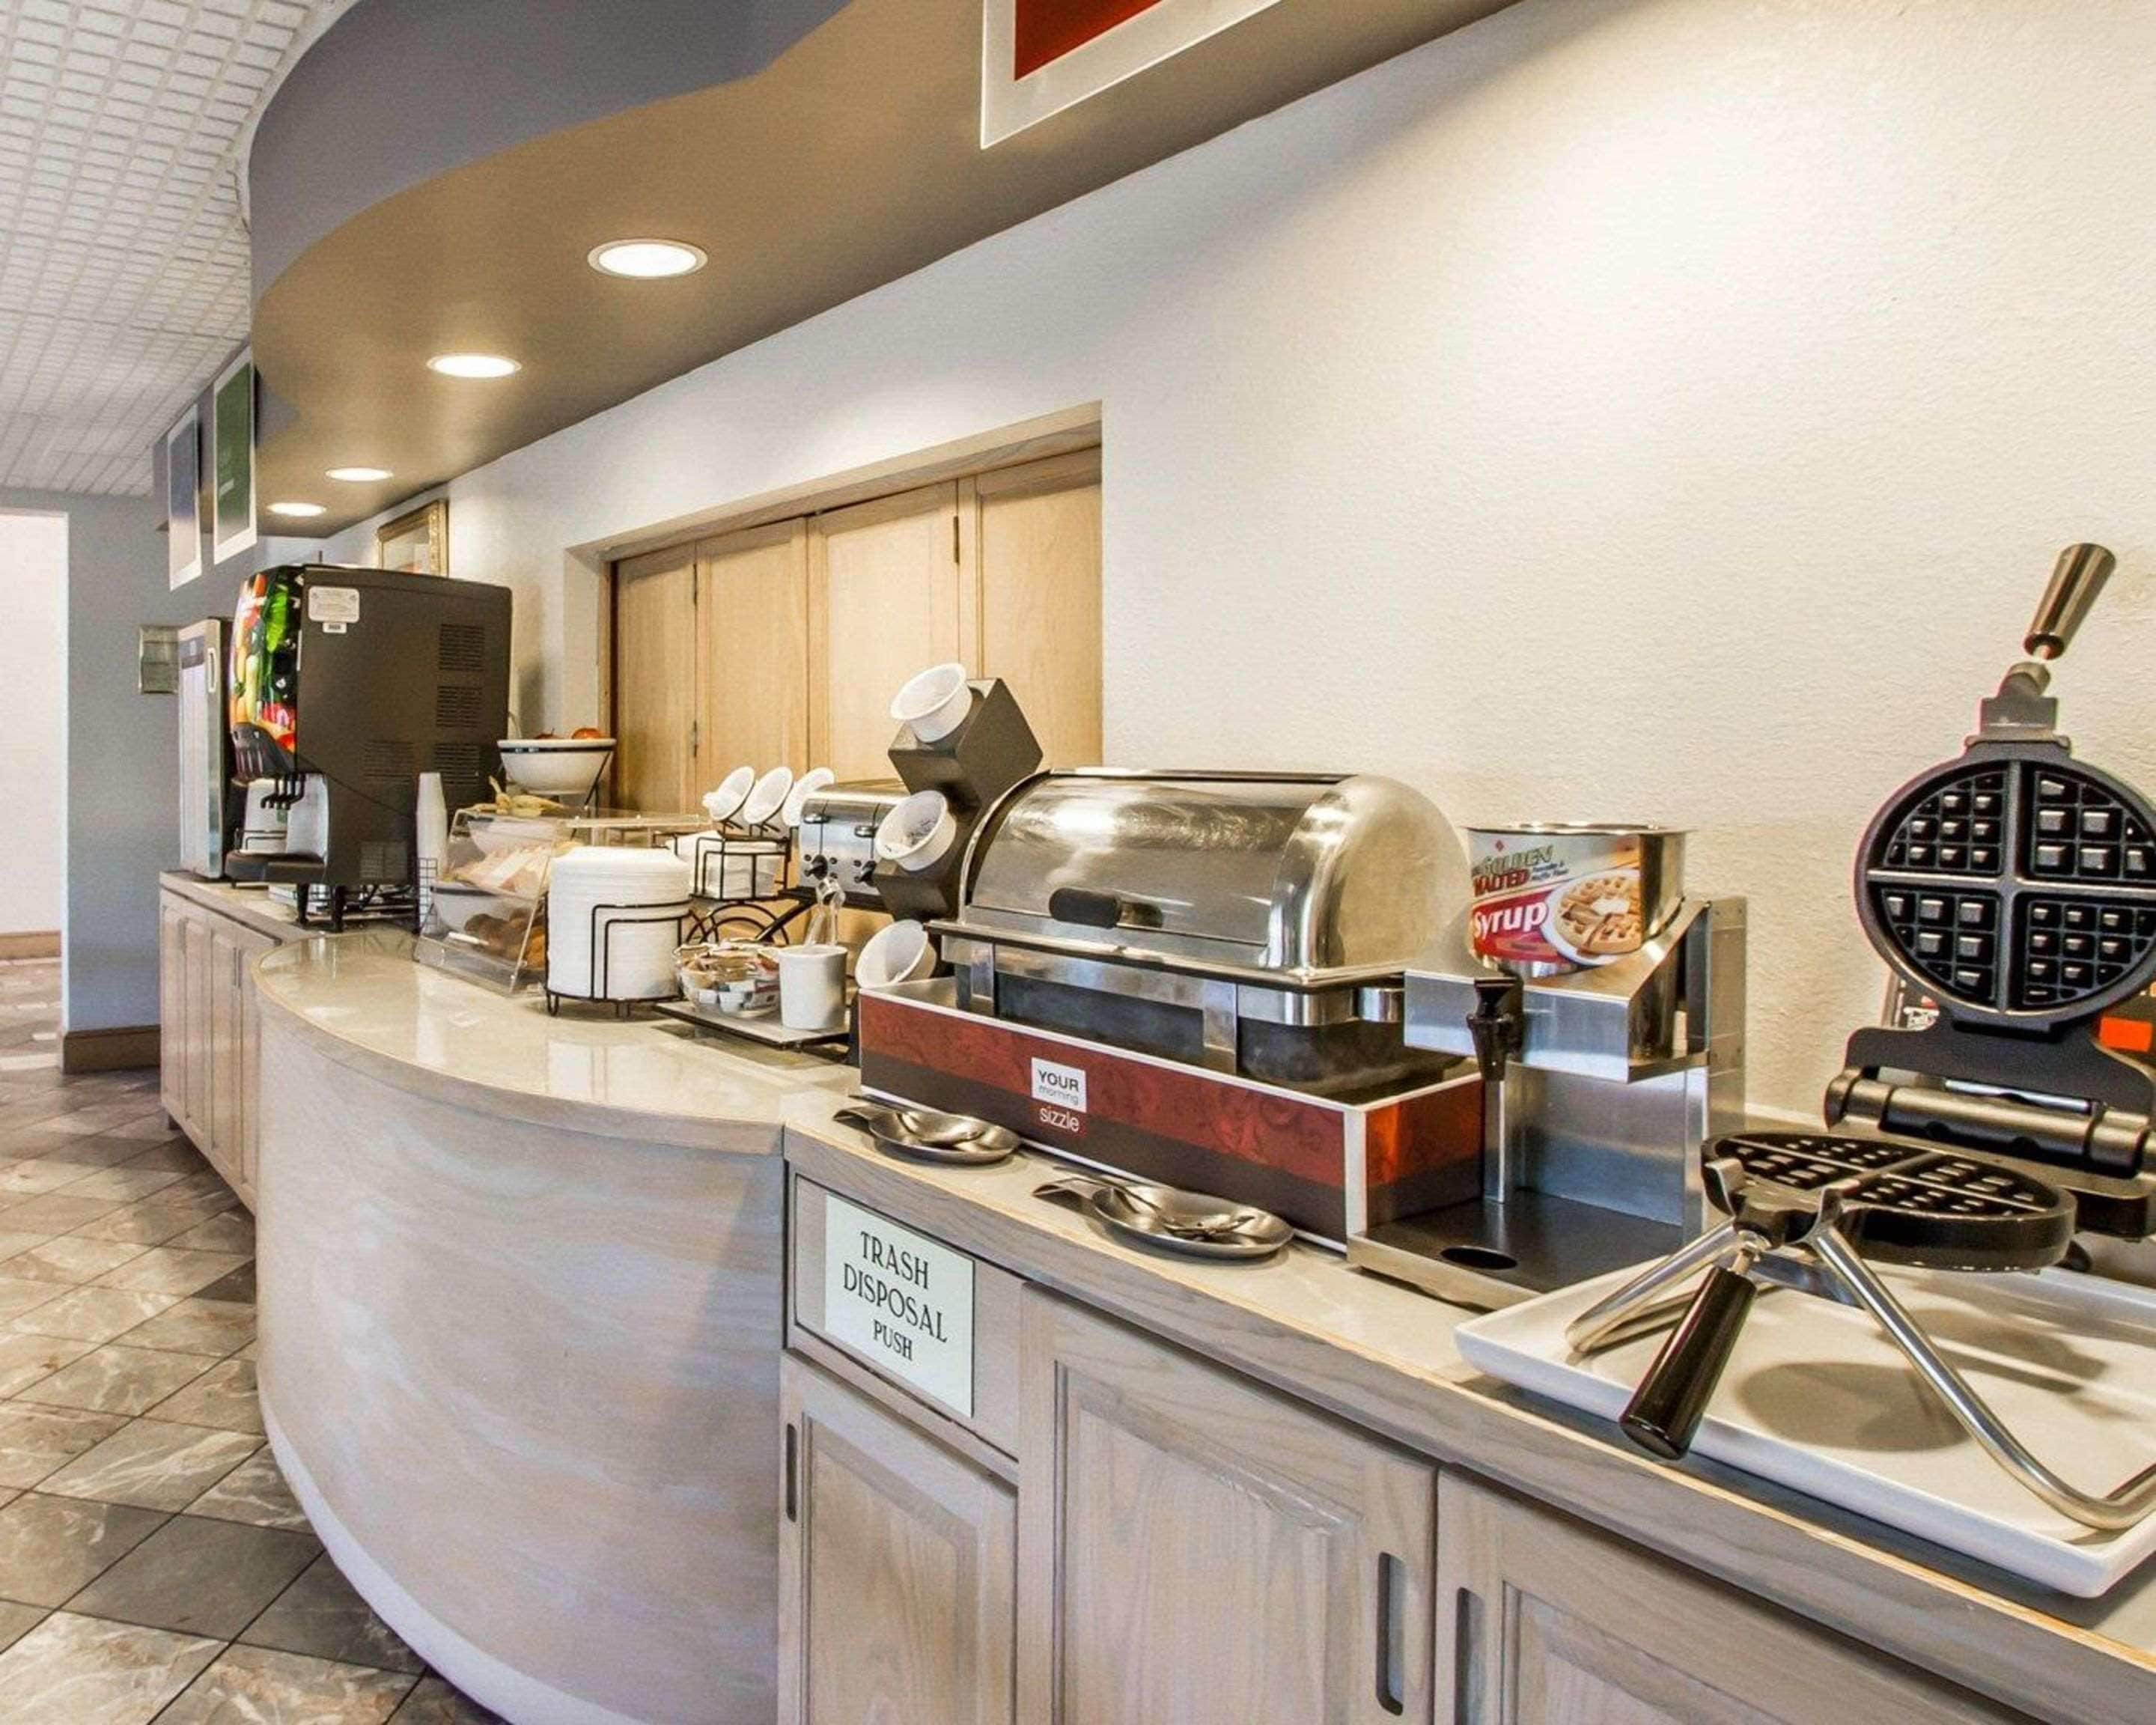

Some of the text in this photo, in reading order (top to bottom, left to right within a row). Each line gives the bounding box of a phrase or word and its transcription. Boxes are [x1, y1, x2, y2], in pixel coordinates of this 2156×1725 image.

[1038, 1069, 1079, 1092] YOUR
[1038, 1085, 1079, 1106] morning
[1039, 1104, 1079, 1132] sizzle
[860, 1231, 928, 1289] TRASH
[843, 1262, 948, 1343] DISPOSAL
[872, 1319, 913, 1361] PUSH
